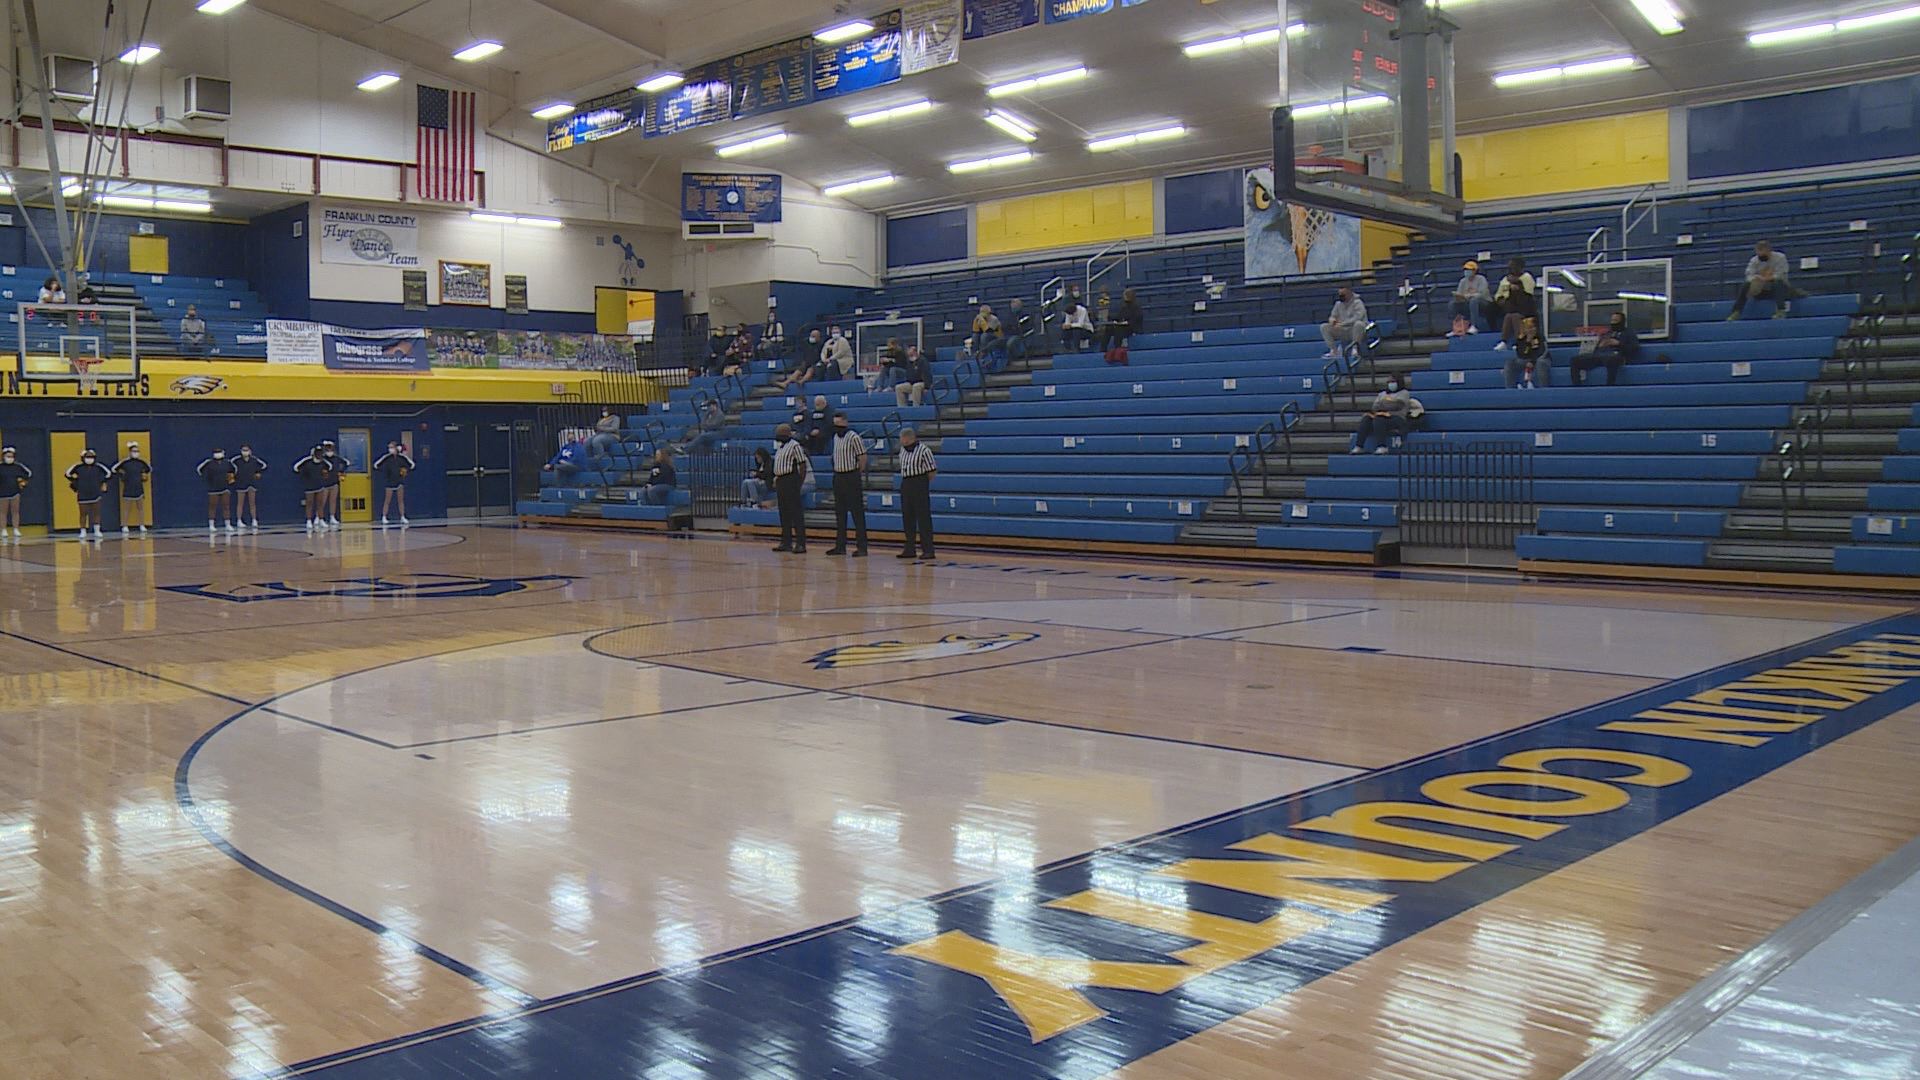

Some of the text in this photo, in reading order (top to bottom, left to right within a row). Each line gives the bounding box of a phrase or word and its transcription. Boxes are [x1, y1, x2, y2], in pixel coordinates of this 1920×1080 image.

[325, 210, 416, 225] FRANKLIN COUNTY
[323, 224, 355, 241] Flyer
[352, 239, 390, 251] Dance
[386, 252, 419, 265] Team
[335, 341, 383, 356] Bluegrass
[1132, 384, 1143, 394] 20
[1701, 433, 1717, 447] 15
[1361, 508, 1370, 520] 3
[1604, 514, 1614, 527] 2
[888, 747, 1691, 1045] COUNTY
